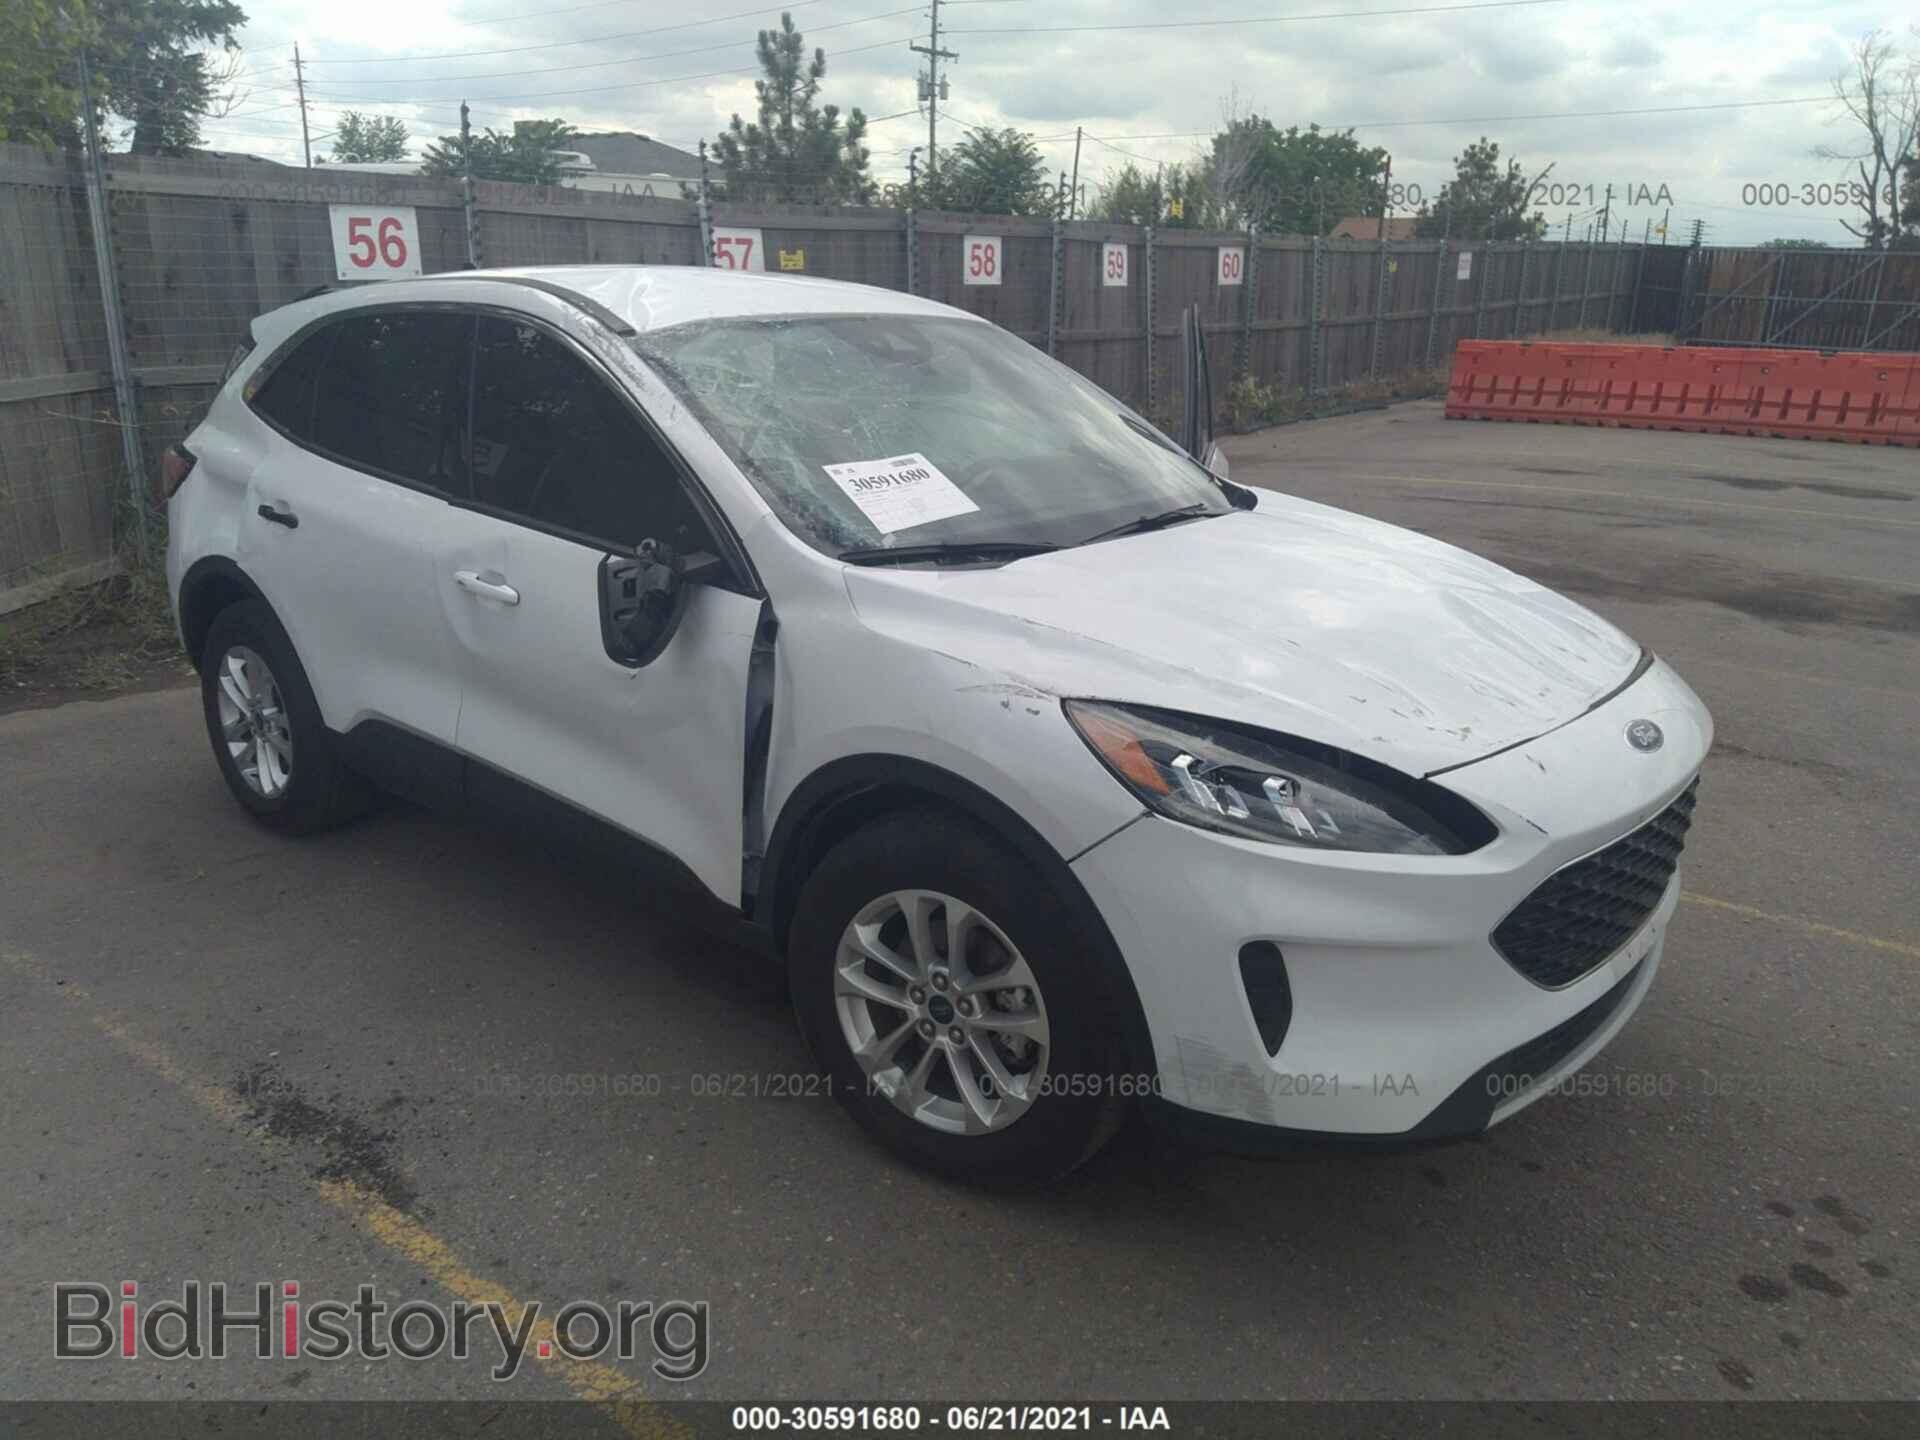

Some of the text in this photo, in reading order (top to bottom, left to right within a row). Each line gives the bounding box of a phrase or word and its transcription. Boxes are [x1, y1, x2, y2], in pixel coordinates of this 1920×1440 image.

[348, 217, 408, 269] 56
[715, 237, 754, 272] 57
[969, 243, 996, 277] 58
[1107, 250, 1124, 279] 59
[1222, 252, 1240, 279] 60
[848, 467, 931, 492] 30591680
